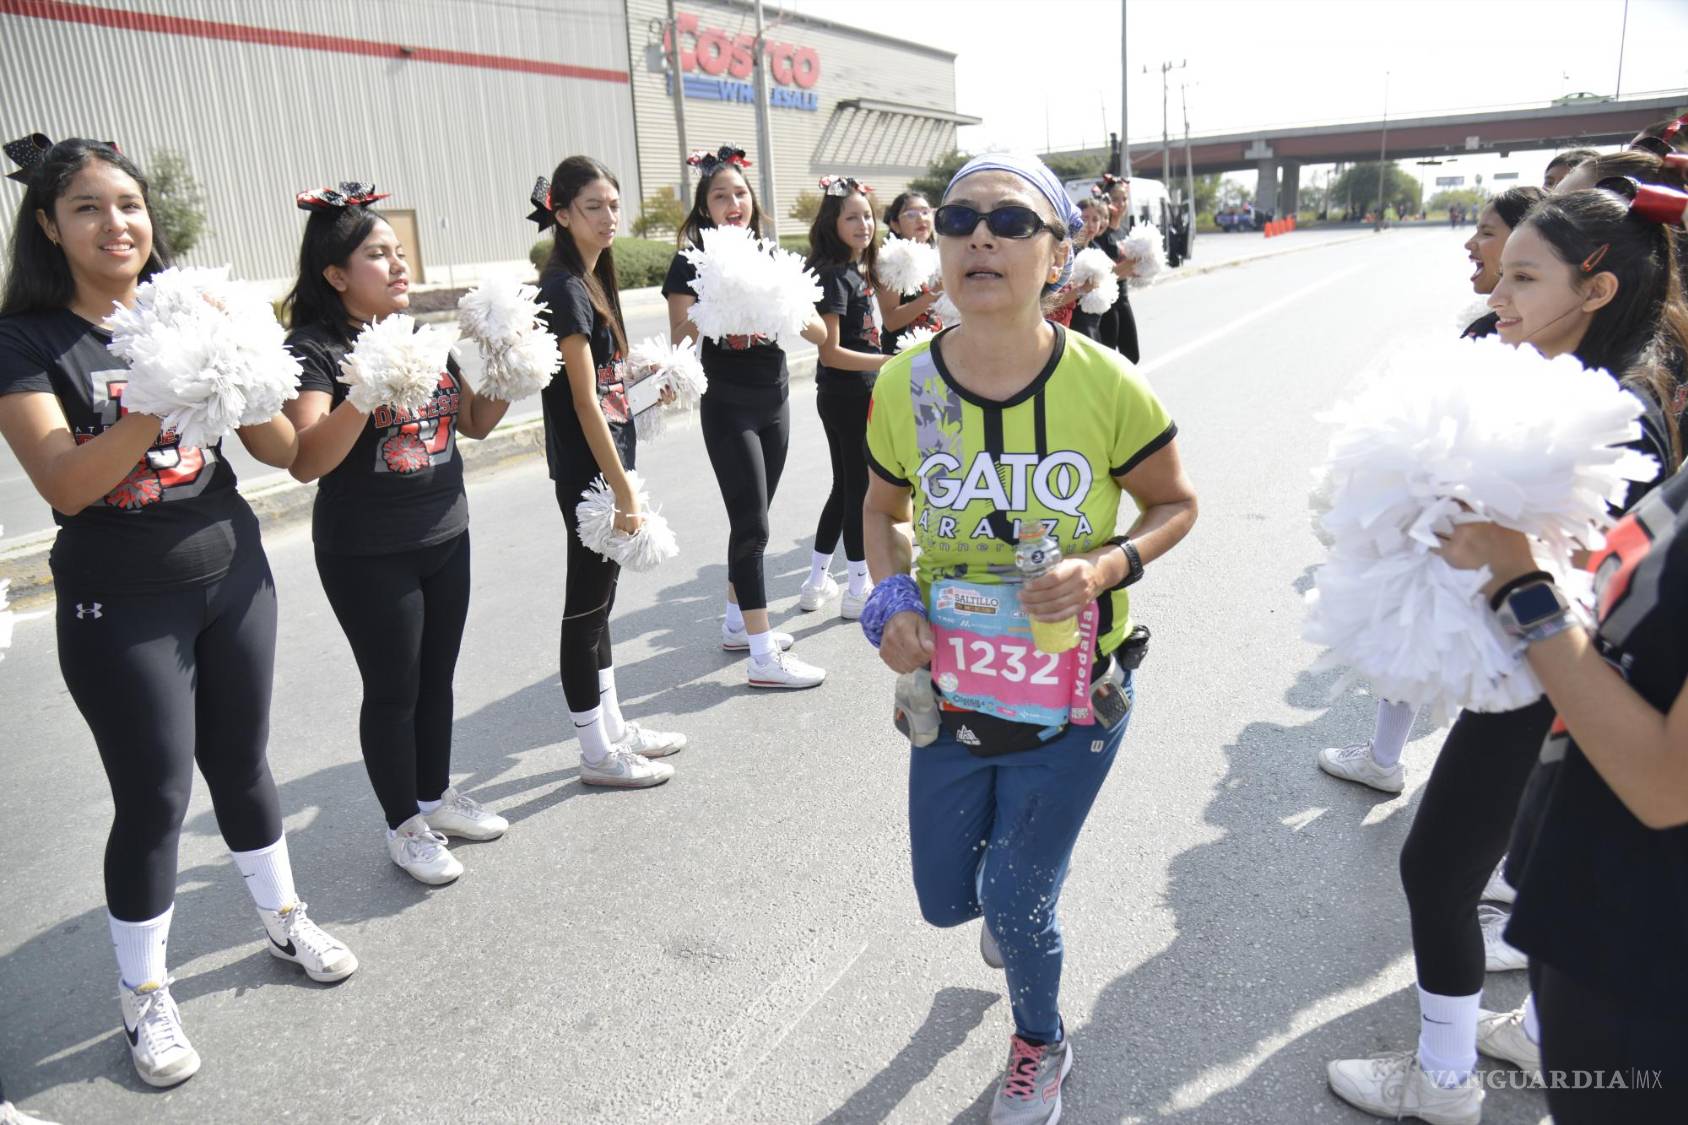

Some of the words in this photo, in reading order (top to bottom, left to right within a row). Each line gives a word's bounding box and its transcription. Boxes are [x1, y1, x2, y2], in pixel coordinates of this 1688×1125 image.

[717, 79, 818, 112] WHESALE
[954, 593, 999, 607] SALTILLO
[948, 637, 1060, 685] 1232
[1075, 611, 1093, 697] Medalla
